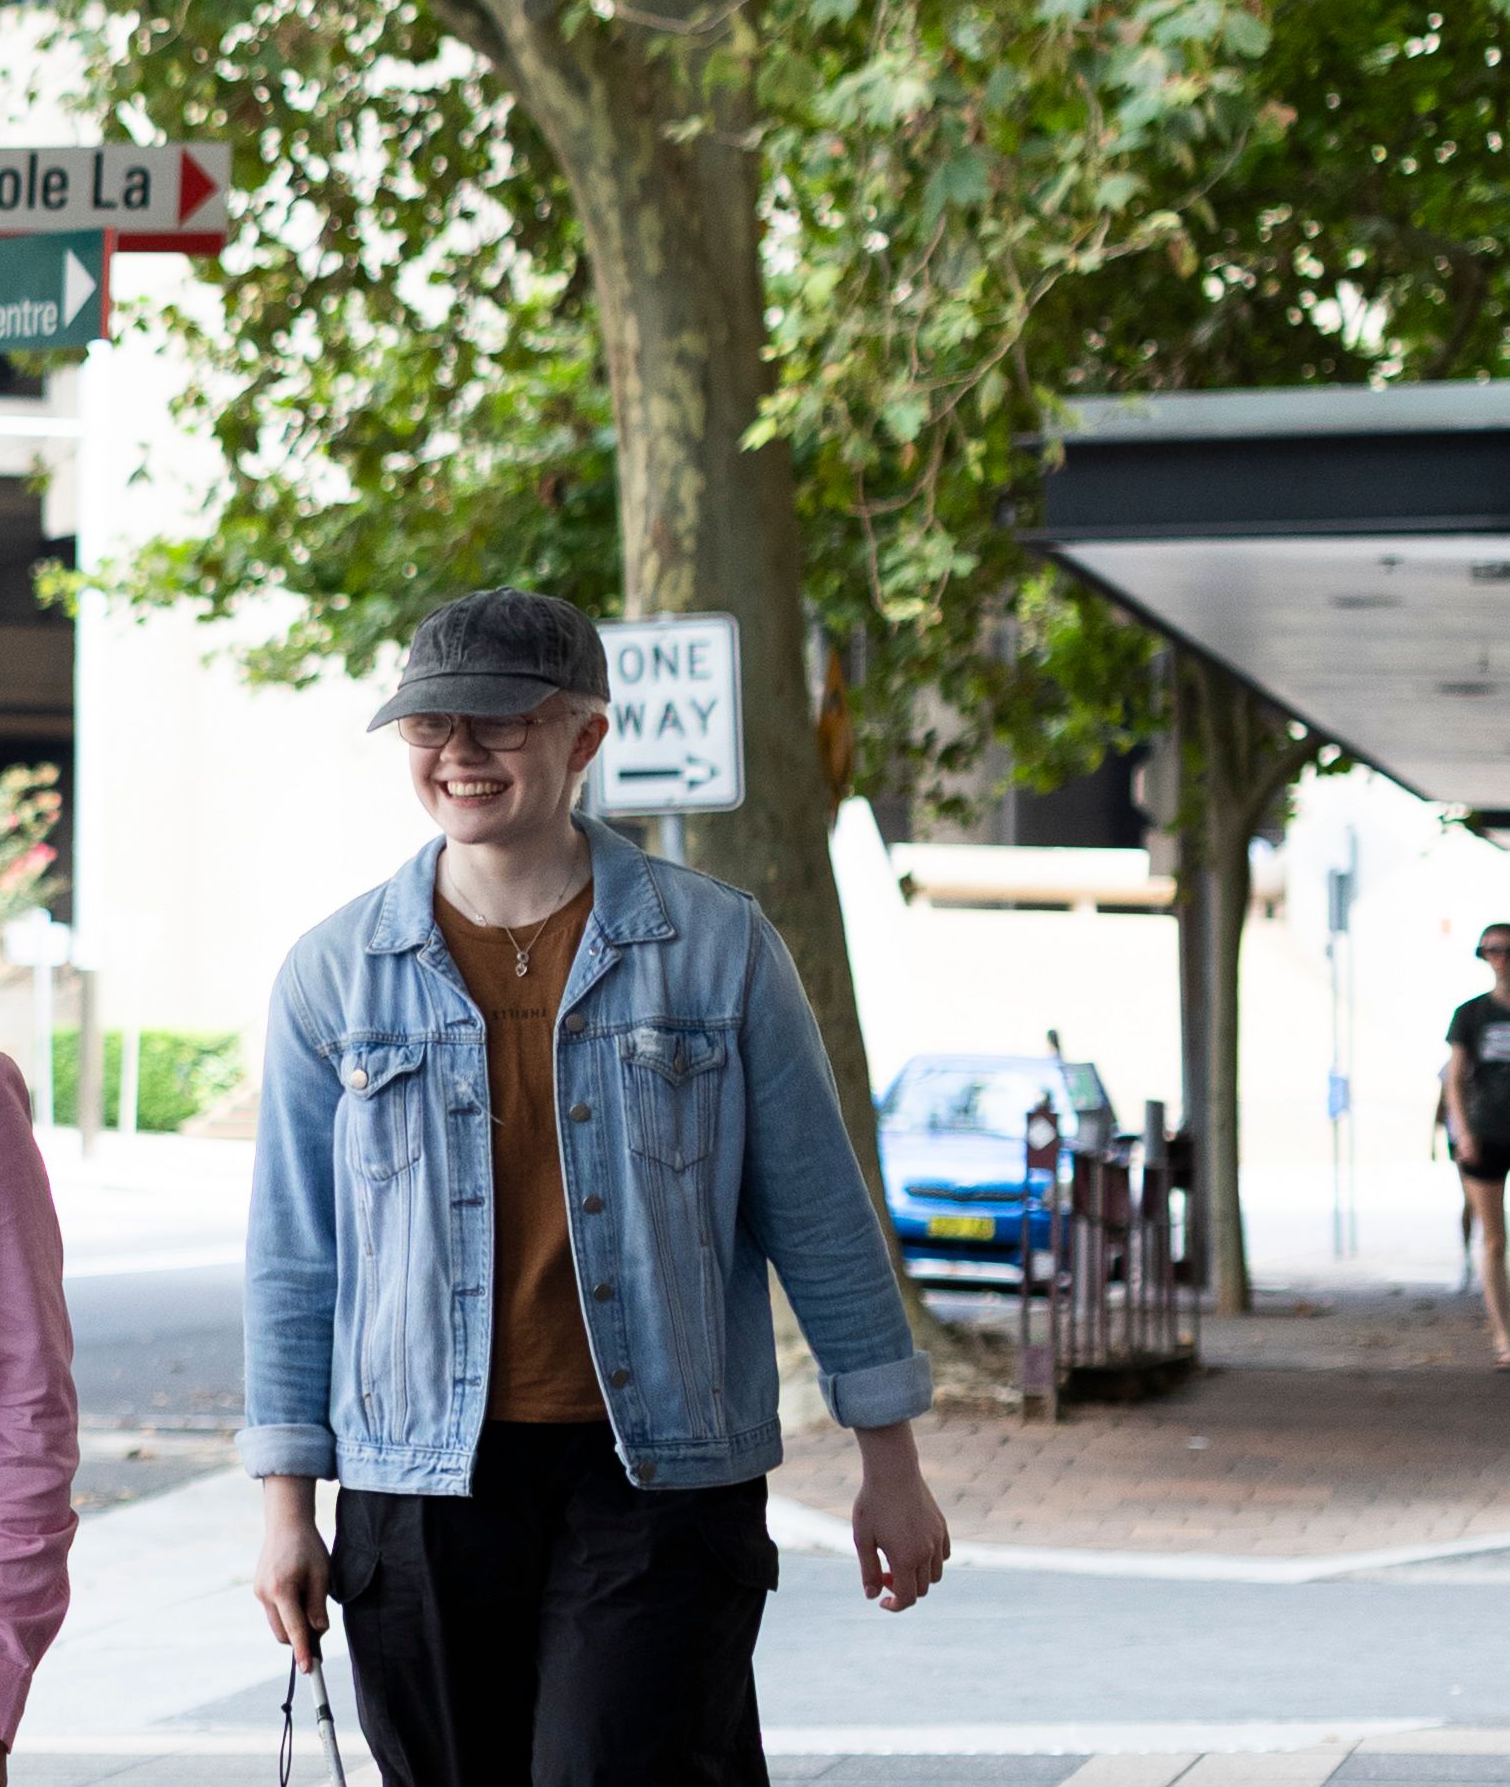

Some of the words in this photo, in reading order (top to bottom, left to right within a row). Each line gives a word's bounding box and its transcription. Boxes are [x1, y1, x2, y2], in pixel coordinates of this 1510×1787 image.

[93, 151, 151, 210] La
[617, 639, 712, 684] ONE
[613, 697, 718, 740] WAY
[491, 1008, 547, 1020] THRILLS
